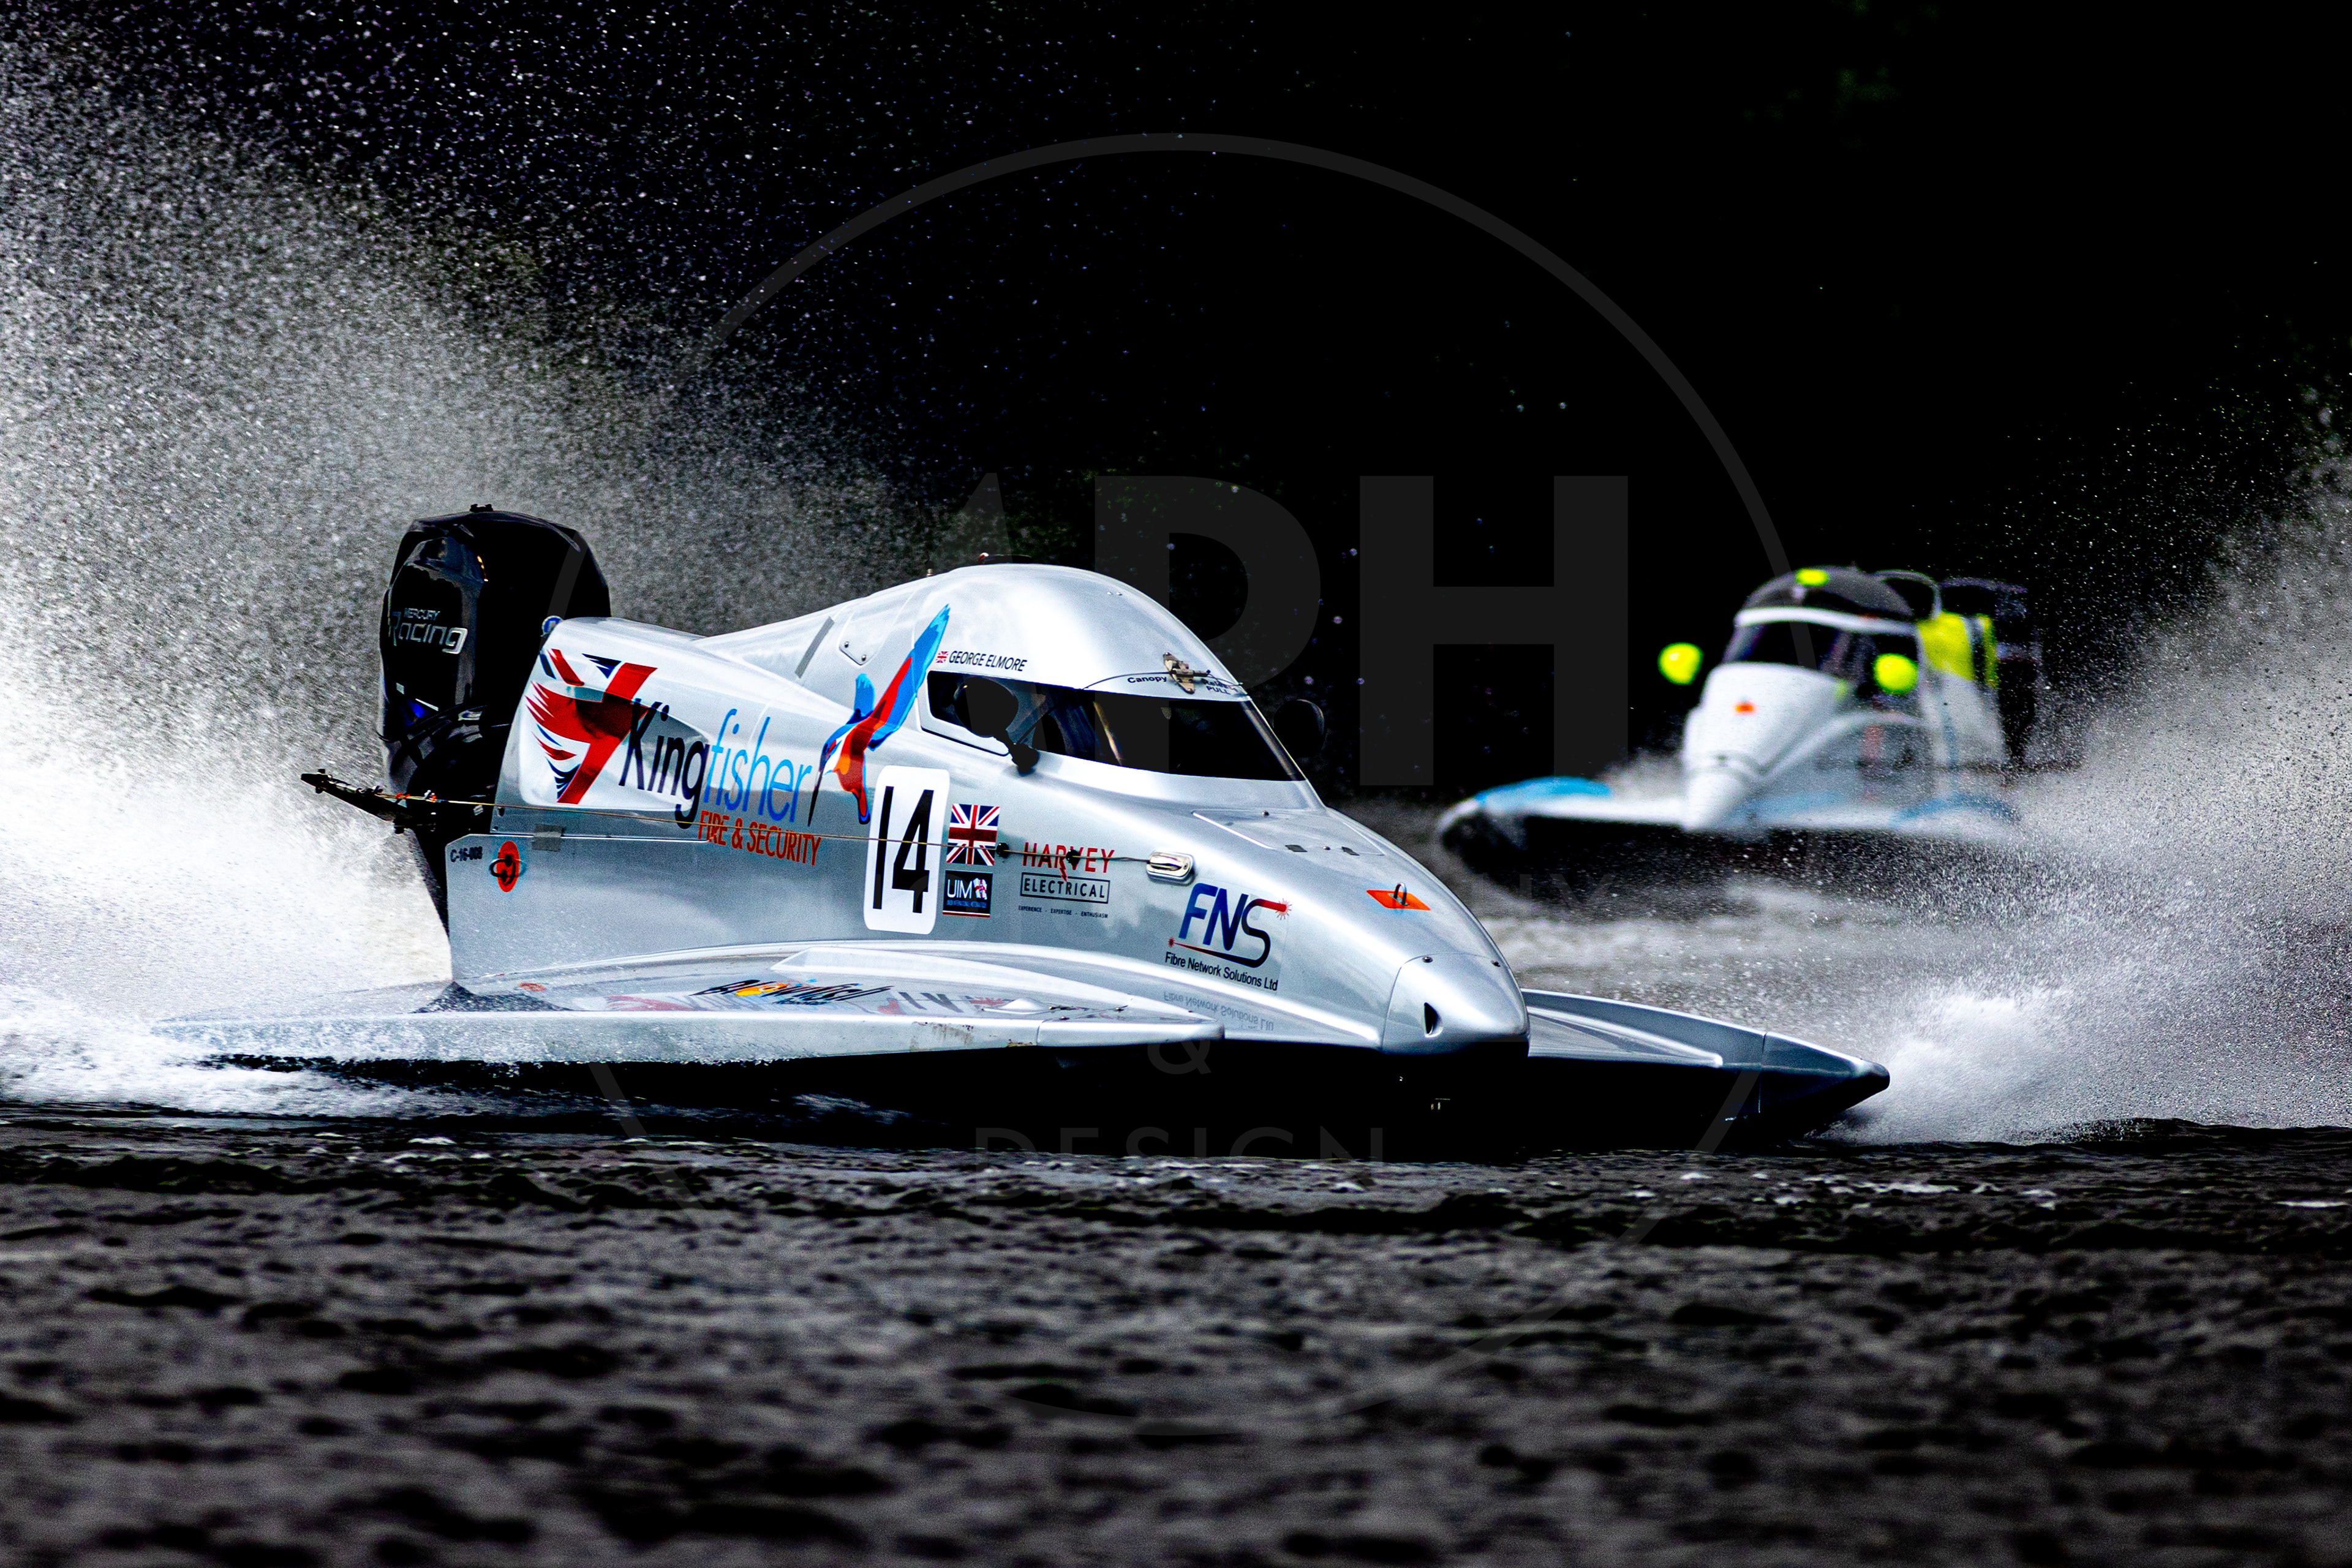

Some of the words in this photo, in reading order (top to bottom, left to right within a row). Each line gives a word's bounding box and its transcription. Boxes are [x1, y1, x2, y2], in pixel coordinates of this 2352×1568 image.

[390, 611, 468, 654] Racing
[949, 650, 985, 666] GEORGE
[986, 655, 1028, 672] ELMORE
[1127, 676, 1167, 684] Canopy
[1205, 686, 1231, 695] PULL
[619, 698, 812, 829] Kingfisher
[698, 810, 729, 846] FIRE
[731, 818, 743, 850] &
[747, 821, 822, 866] SECURITY
[872, 785, 935, 914] 14
[1022, 842, 1115, 874] HARVEY
[947, 878, 973, 899] UIM
[1023, 878, 1105, 899] ELECTRICAL
[1174, 883, 1286, 968] FNS
[1165, 951, 1186, 967] Fibre
[1187, 957, 1221, 977] Network
[1223, 967, 1262, 987] Solutions
[1264, 977, 1278, 991] Ltd
